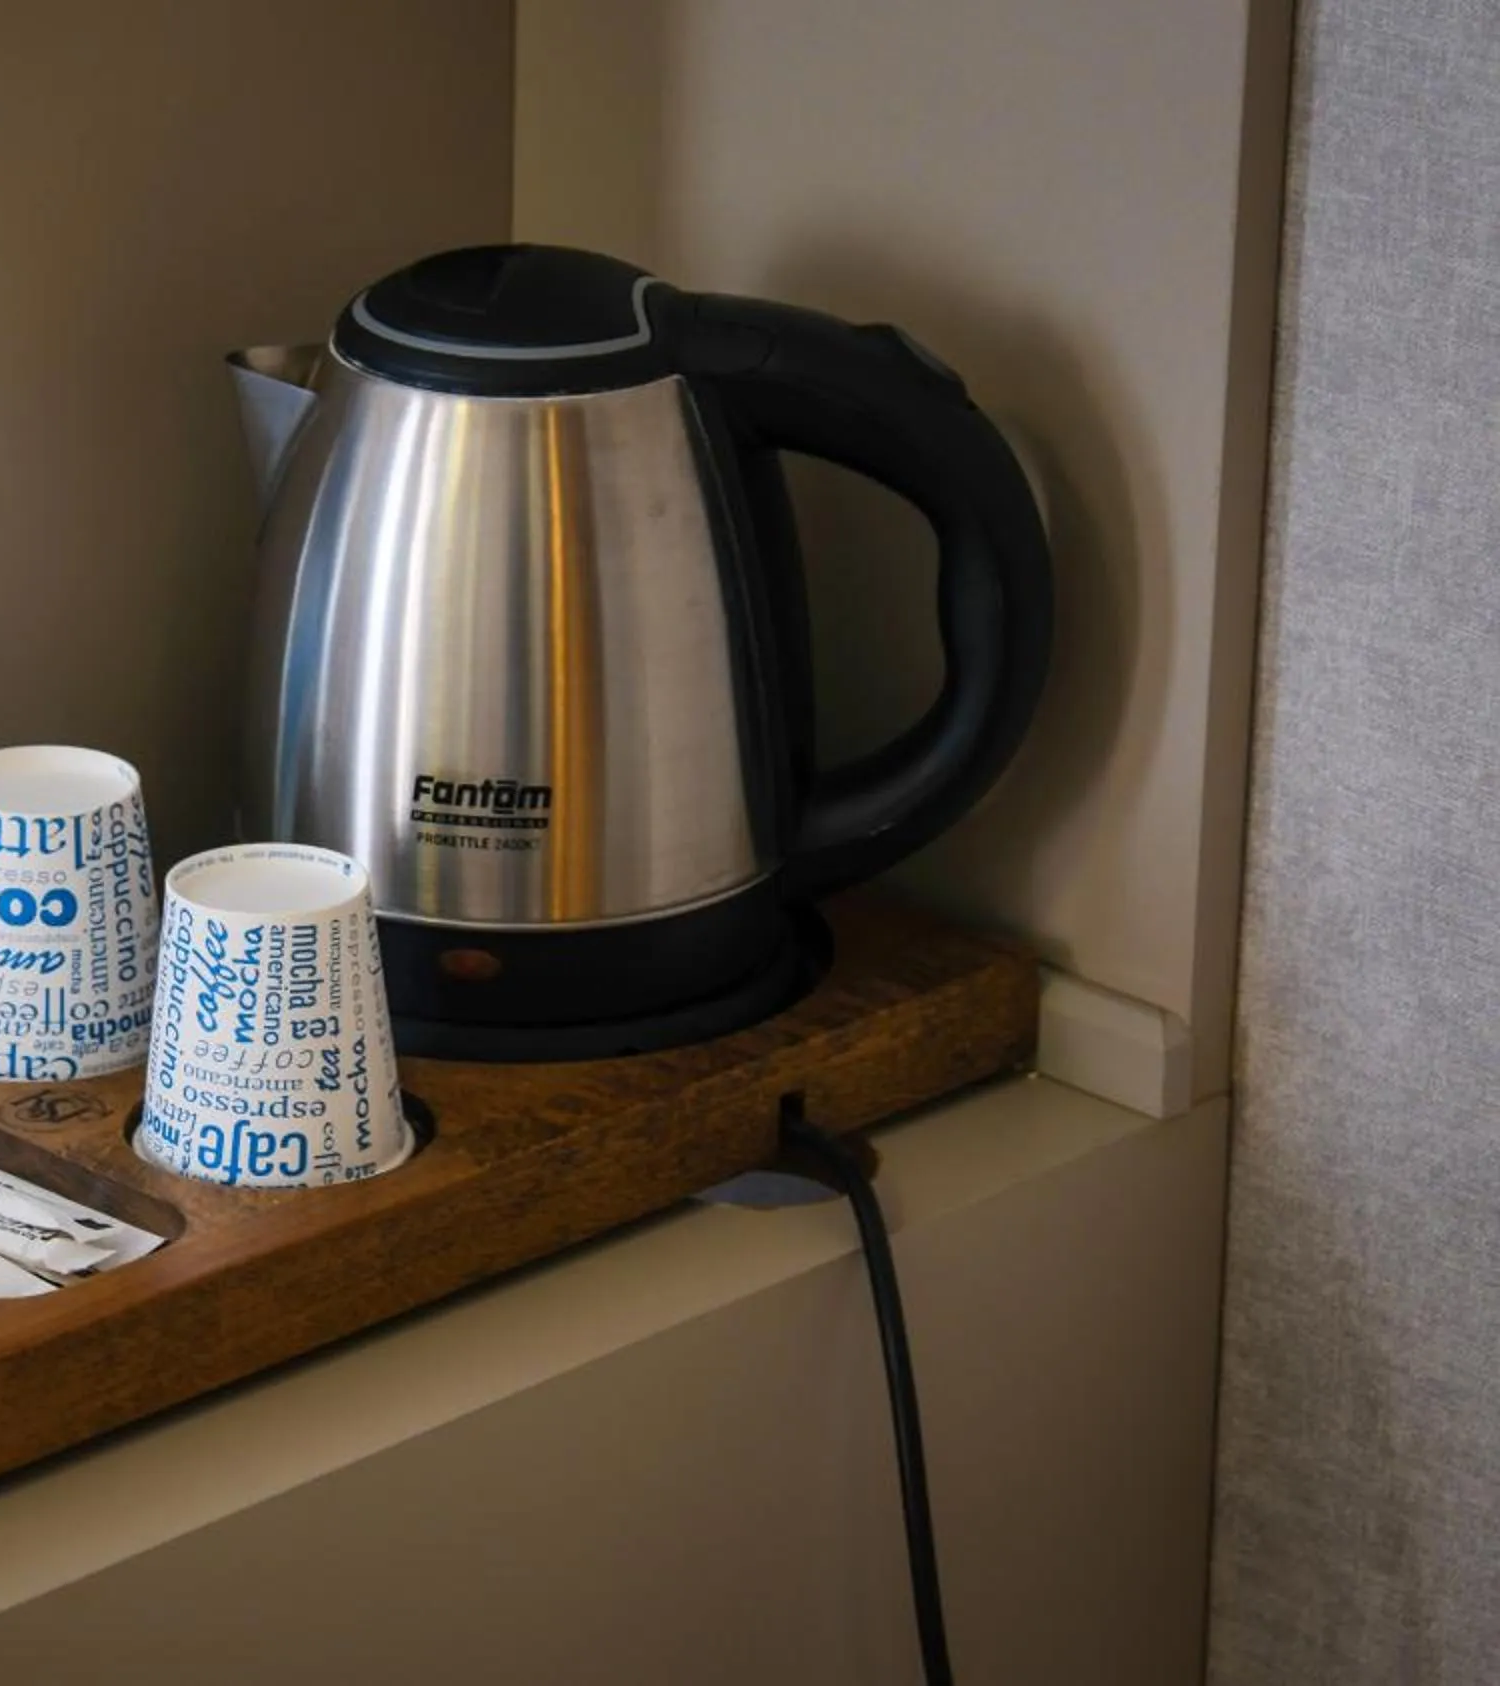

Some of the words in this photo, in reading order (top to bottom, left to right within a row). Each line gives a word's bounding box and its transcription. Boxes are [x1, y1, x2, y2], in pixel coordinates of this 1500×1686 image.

[104, 802, 139, 983] cappuccino
[159, 907, 194, 1090] cappuccino
[232, 923, 265, 1045] mocha
[263, 924, 288, 1046] americano
[288, 923, 325, 1010] mocha
[71, 1004, 152, 1045] mocha
[193, 1039, 314, 1074] coffee
[290, 1014, 340, 1040] tea
[182, 1084, 327, 1119] espresso
[313, 1043, 341, 1093] tea
[346, 1034, 372, 1153] mocha
[197, 1118, 310, 1185] cafe
[313, 1120, 343, 1186] coffe
